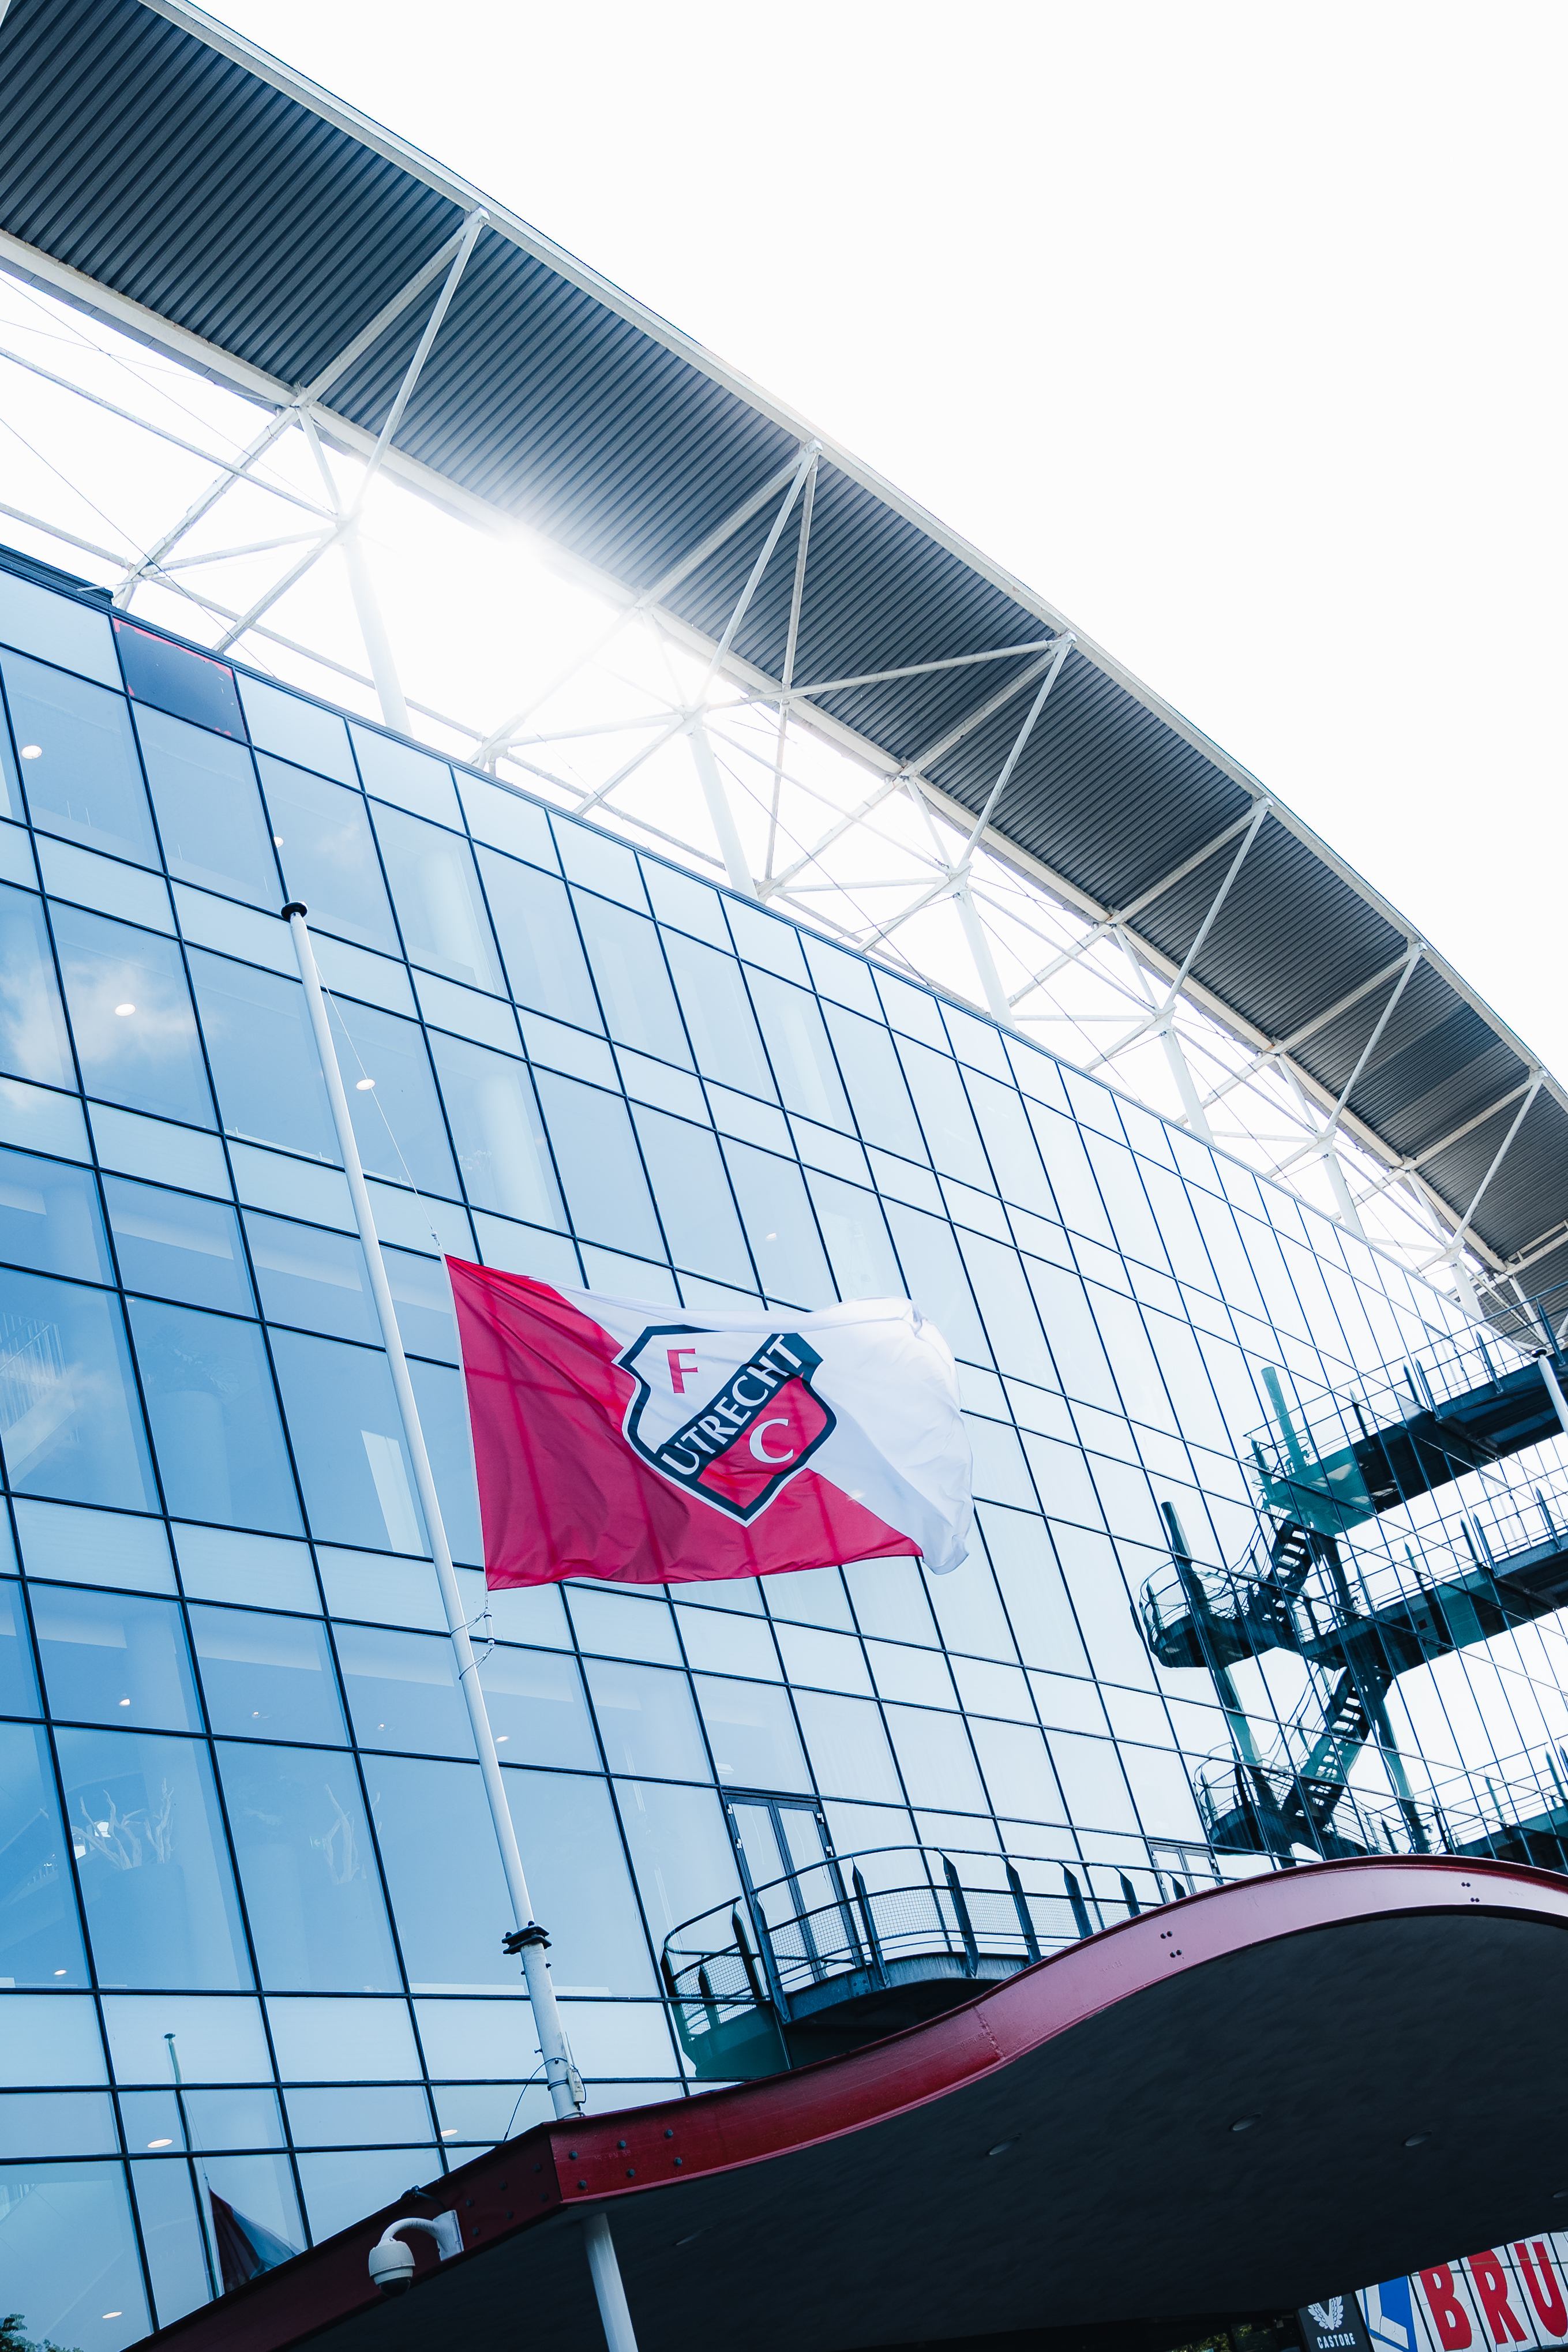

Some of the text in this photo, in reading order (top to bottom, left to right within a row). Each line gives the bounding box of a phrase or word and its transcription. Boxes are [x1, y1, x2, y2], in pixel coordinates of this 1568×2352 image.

[667, 1348, 698, 1394] F
[661, 1334, 802, 1475] UTRECHT
[749, 1418, 793, 1464] C
[1316, 2332, 1356, 2349] CASTORE
